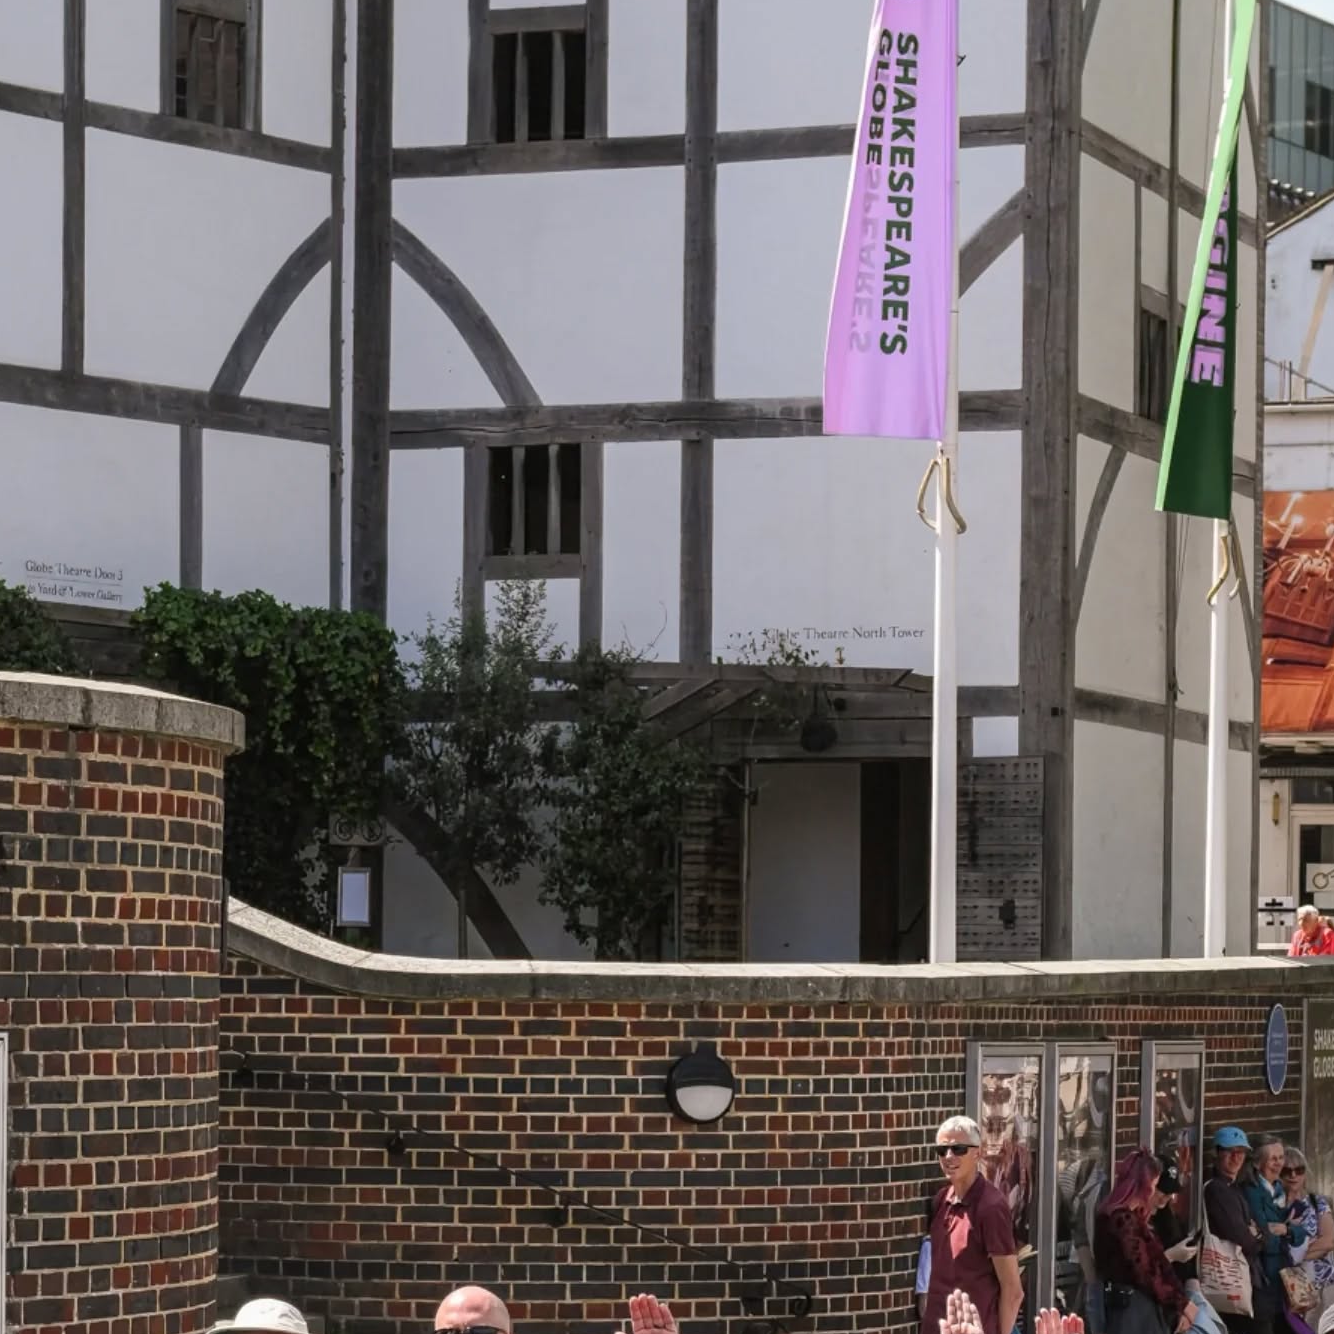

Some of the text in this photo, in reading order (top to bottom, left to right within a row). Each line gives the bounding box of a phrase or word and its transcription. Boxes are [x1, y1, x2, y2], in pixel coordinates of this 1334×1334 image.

[866, 28, 893, 166] GLOBE
[880, 31, 919, 356] SHAKESPEARE'S
[25, 560, 54, 574] Globe
[803, 628, 849, 640] Theatre
[852, 627, 887, 639] North
[889, 626, 925, 638] Tower
